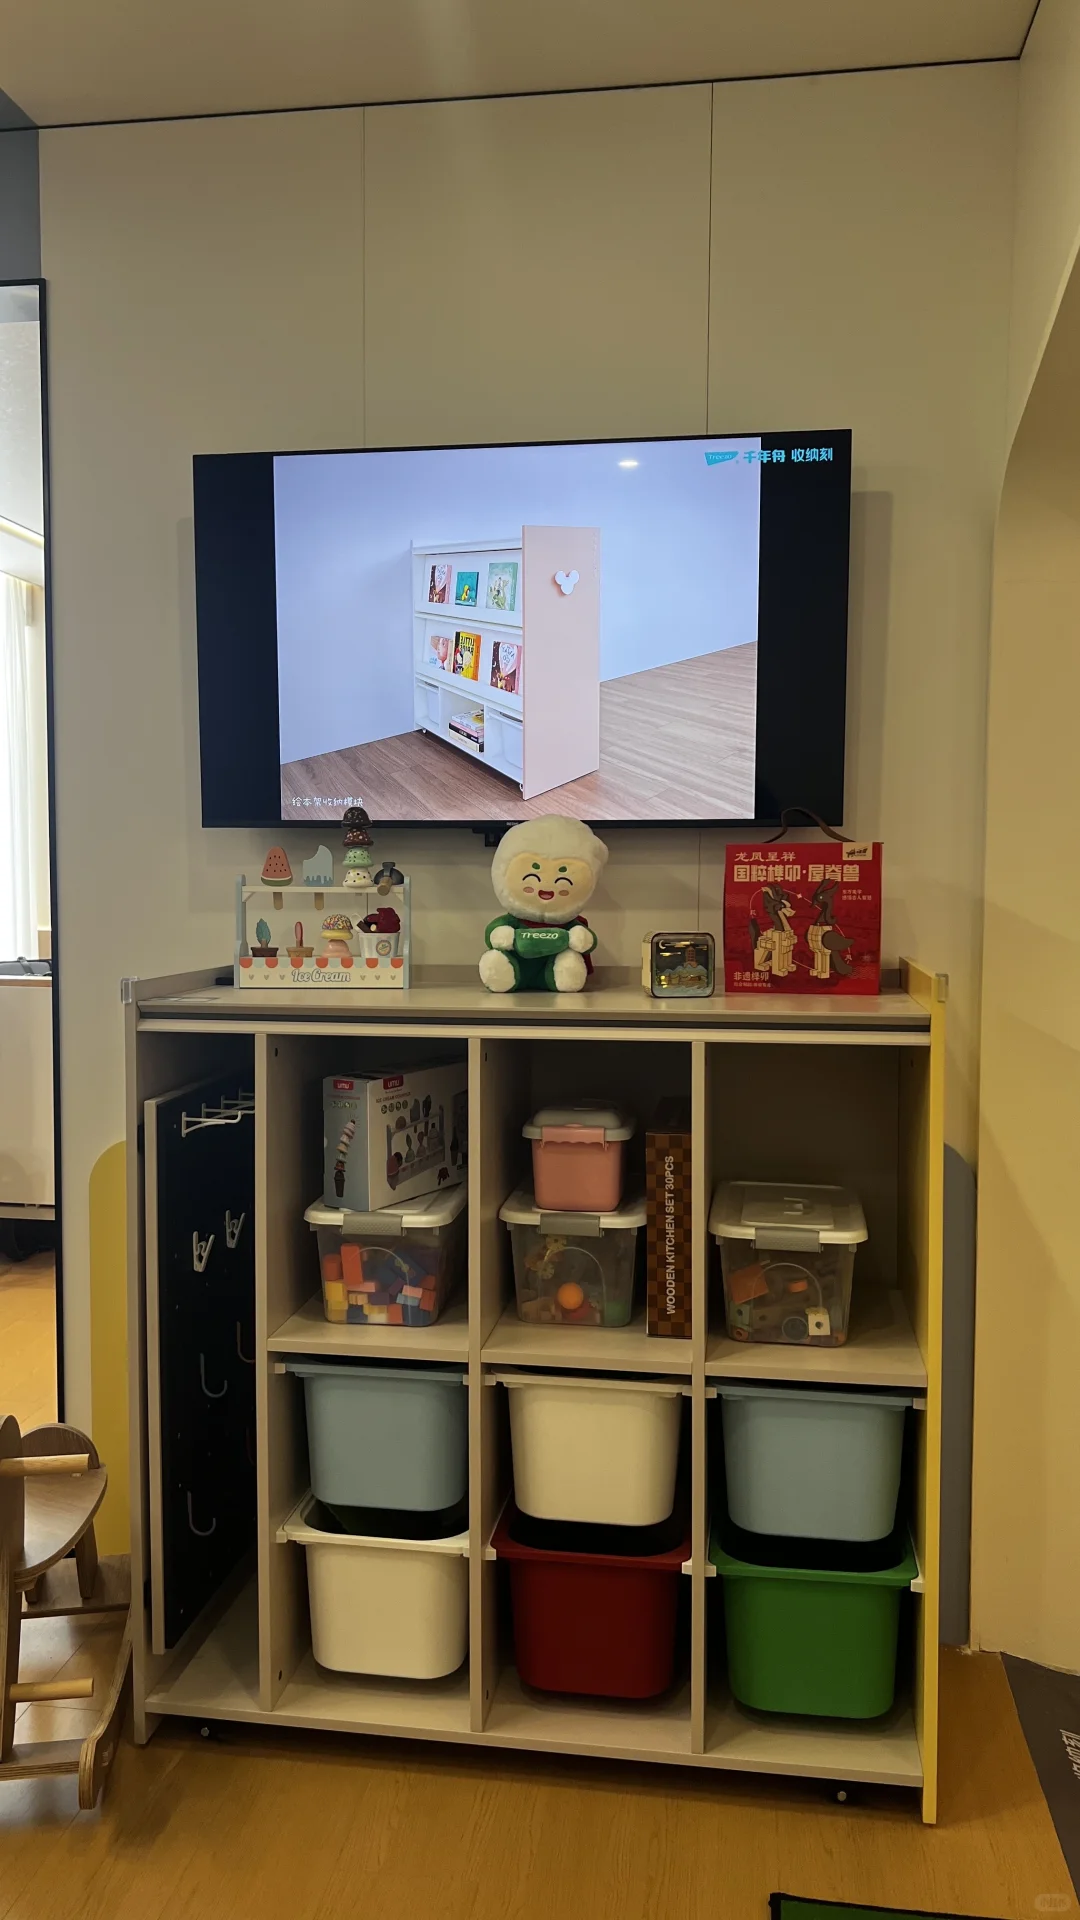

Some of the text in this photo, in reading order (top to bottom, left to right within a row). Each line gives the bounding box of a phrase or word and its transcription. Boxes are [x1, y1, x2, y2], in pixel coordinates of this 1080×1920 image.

[743, 447, 833, 464] 千年舟 收纳刻
[292, 796, 364, 807] 绘本架收纳模块
[734, 851, 797, 862] 龙凤呈祥
[521, 932, 559, 940] Treezo
[291, 968, 351, 983] Ice Cream
[664, 1155, 676, 1315] WOODEN KITCHEN SET 30PCS
